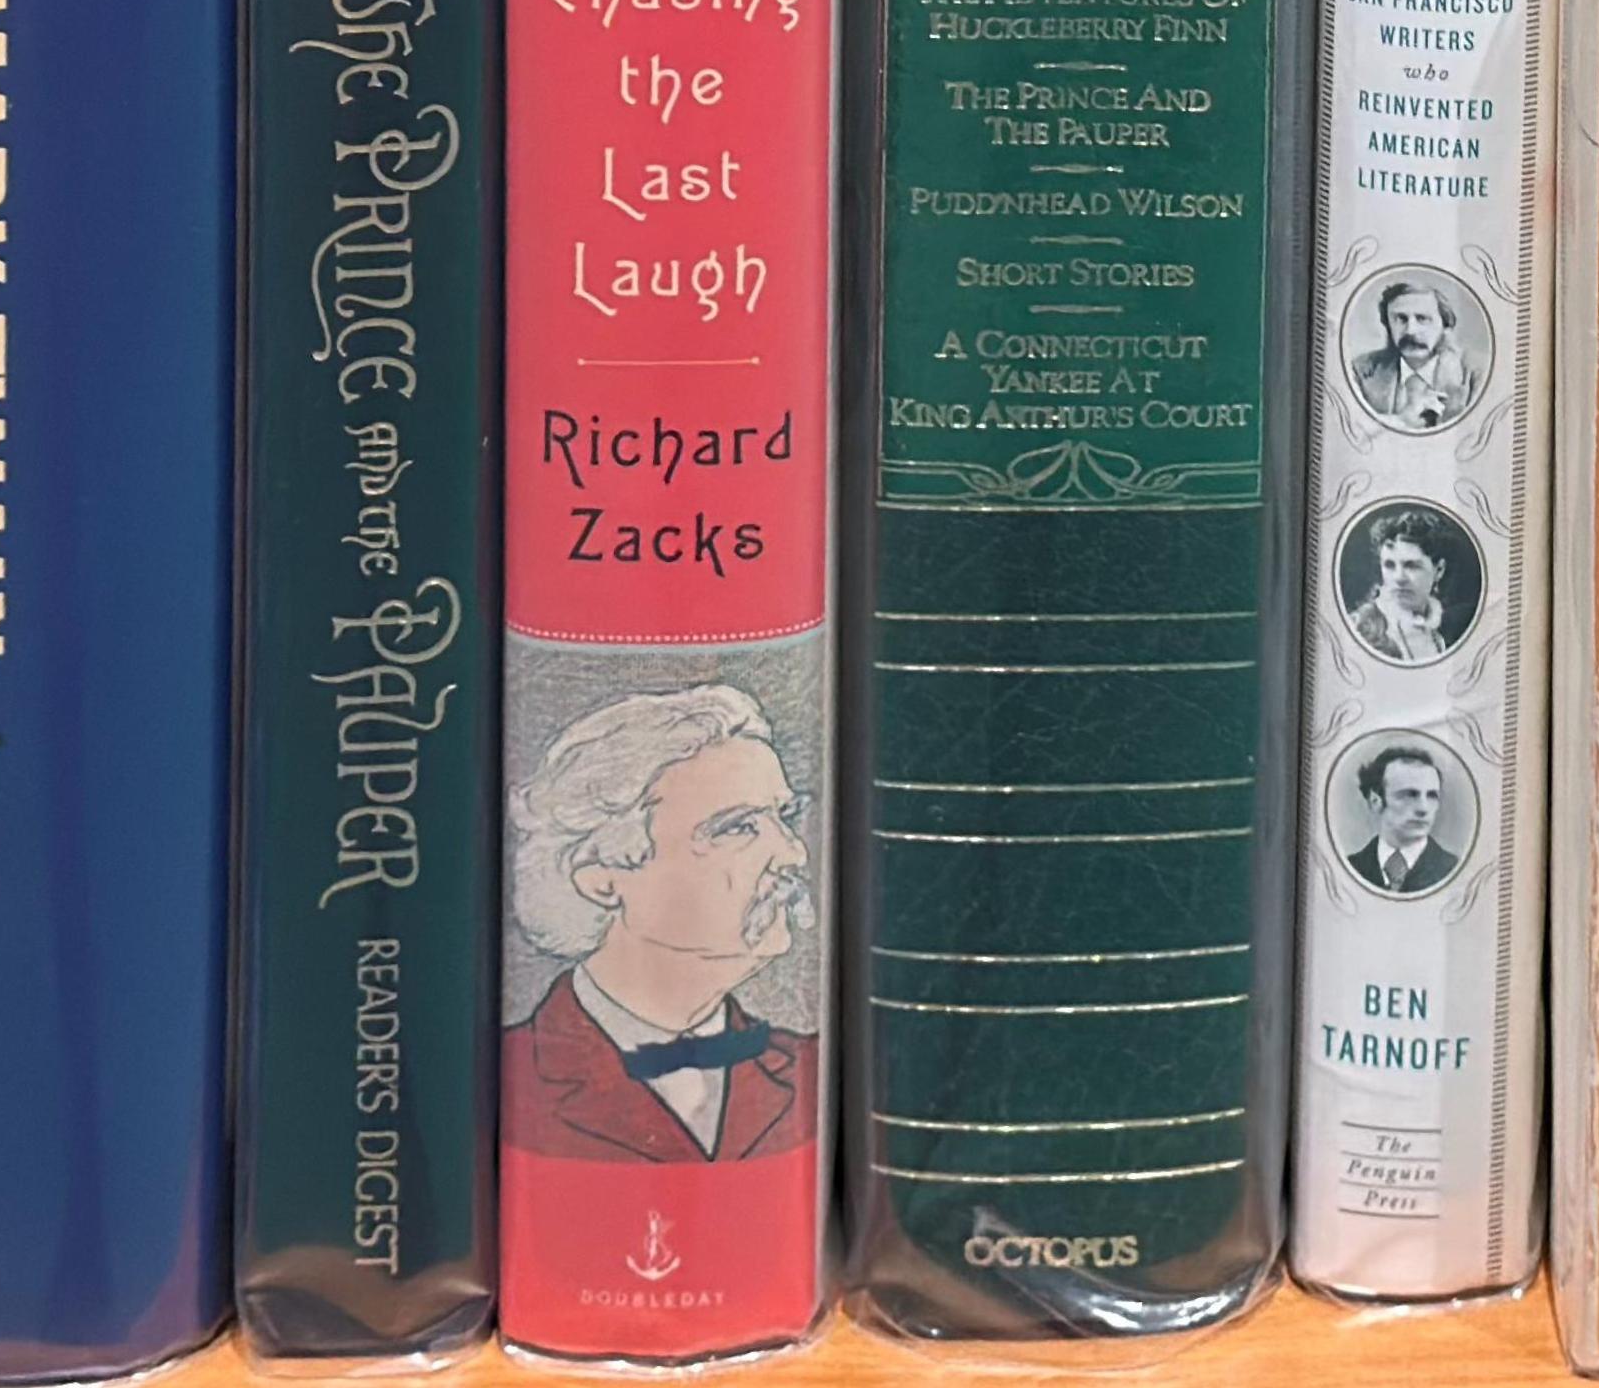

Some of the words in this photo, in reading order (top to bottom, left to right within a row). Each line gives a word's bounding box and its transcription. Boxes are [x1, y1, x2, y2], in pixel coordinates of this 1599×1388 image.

[929, 13, 1145, 41] HUCKLEBERRY
[1153, 15, 1228, 42] FINN
[1379, 24, 1475, 51] WRITERS
[1403, 64, 1449, 81] who
[620, 55, 724, 124] the
[944, 82, 1008, 110] THE
[1017, 83, 1129, 111] PRINCE
[1133, 85, 1212, 113] AND
[1359, 90, 1493, 120] REINVENTED
[984, 117, 1049, 146] THE
[1057, 119, 1170, 148] PAUPER
[1368, 131, 1480, 158] AMERICAN
[602, 148, 740, 221] Last
[1358, 167, 1489, 197] LITERATURE
[1118, 189, 1244, 217] WILSON
[573, 242, 767, 321] Laugh
[956, 259, 1063, 286] SHORT
[1069, 259, 1195, 287] STORIES
[933, 330, 967, 358] A
[976, 330, 1208, 359] CONNECTICUT
[982, 364, 1101, 393] YANKEE
[1108, 369, 1162, 393] AT
[889, 397, 971, 429] KING
[1140, 400, 1252, 428] COURT
[542, 409, 792, 487] Richard
[568, 508, 765, 578] Zacks
[1364, 984, 1427, 1020] BEN
[354, 939, 400, 1114] READER'S
[1322, 1024, 1470, 1070] TARNOFF
[1376, 1135, 1412, 1153] The
[1347, 1159, 1436, 1184] Penguin
[354, 1130, 399, 1274] DIGEST
[1364, 1189, 1418, 1210] Press
[964, 1235, 1138, 1266] OCTOPUS
[580, 1289, 724, 1308] DOUBLEDAY
